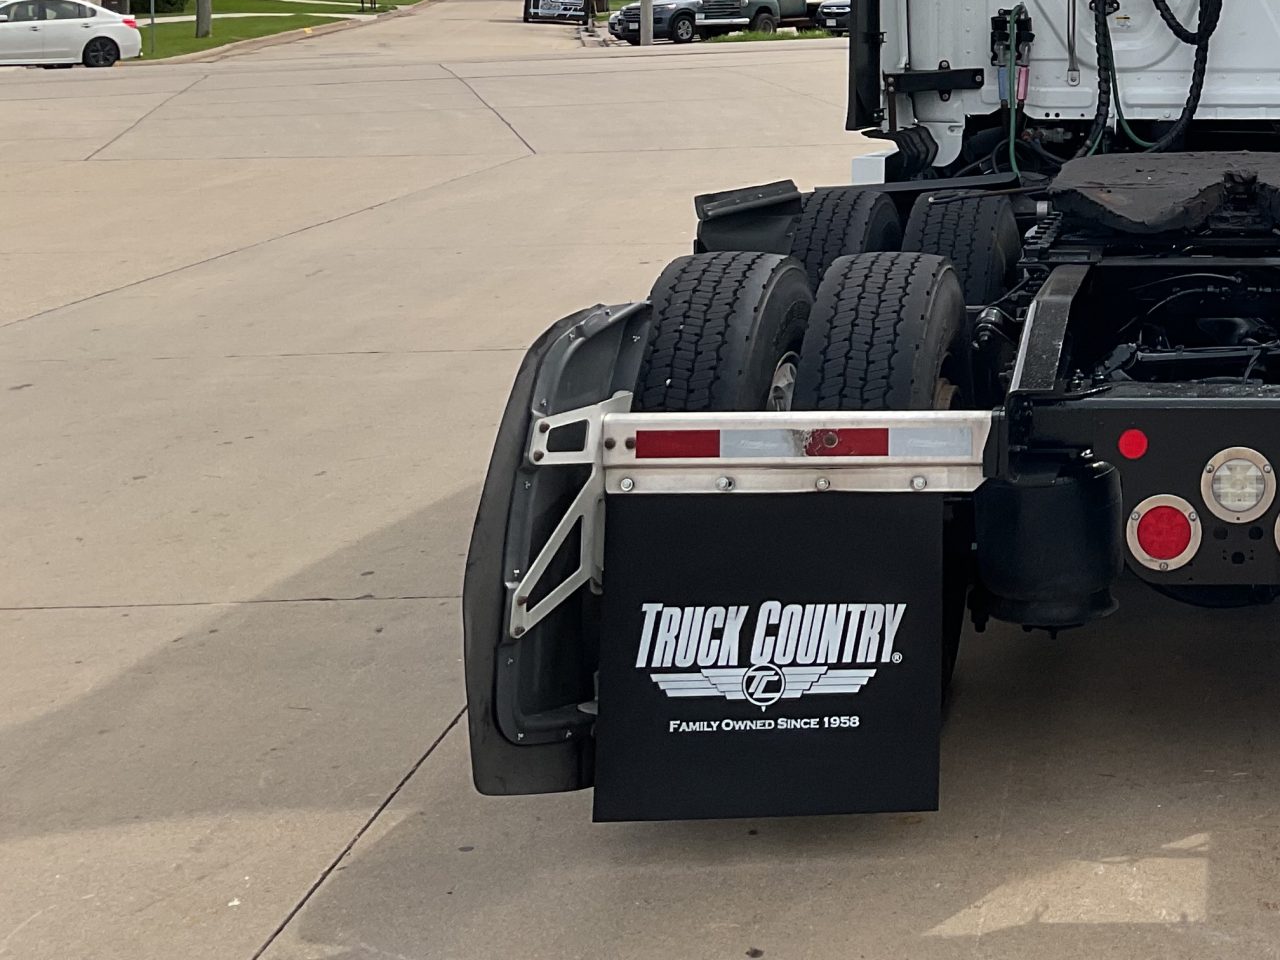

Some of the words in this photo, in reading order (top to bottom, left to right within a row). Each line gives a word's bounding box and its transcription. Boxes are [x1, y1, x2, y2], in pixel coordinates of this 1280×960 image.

[636, 603, 749, 668] TRUCK
[669, 719, 720, 733] FAMILY
[721, 719, 775, 731] OWNED
[777, 717, 820, 729] SINCE
[823, 716, 860, 728] 1958
